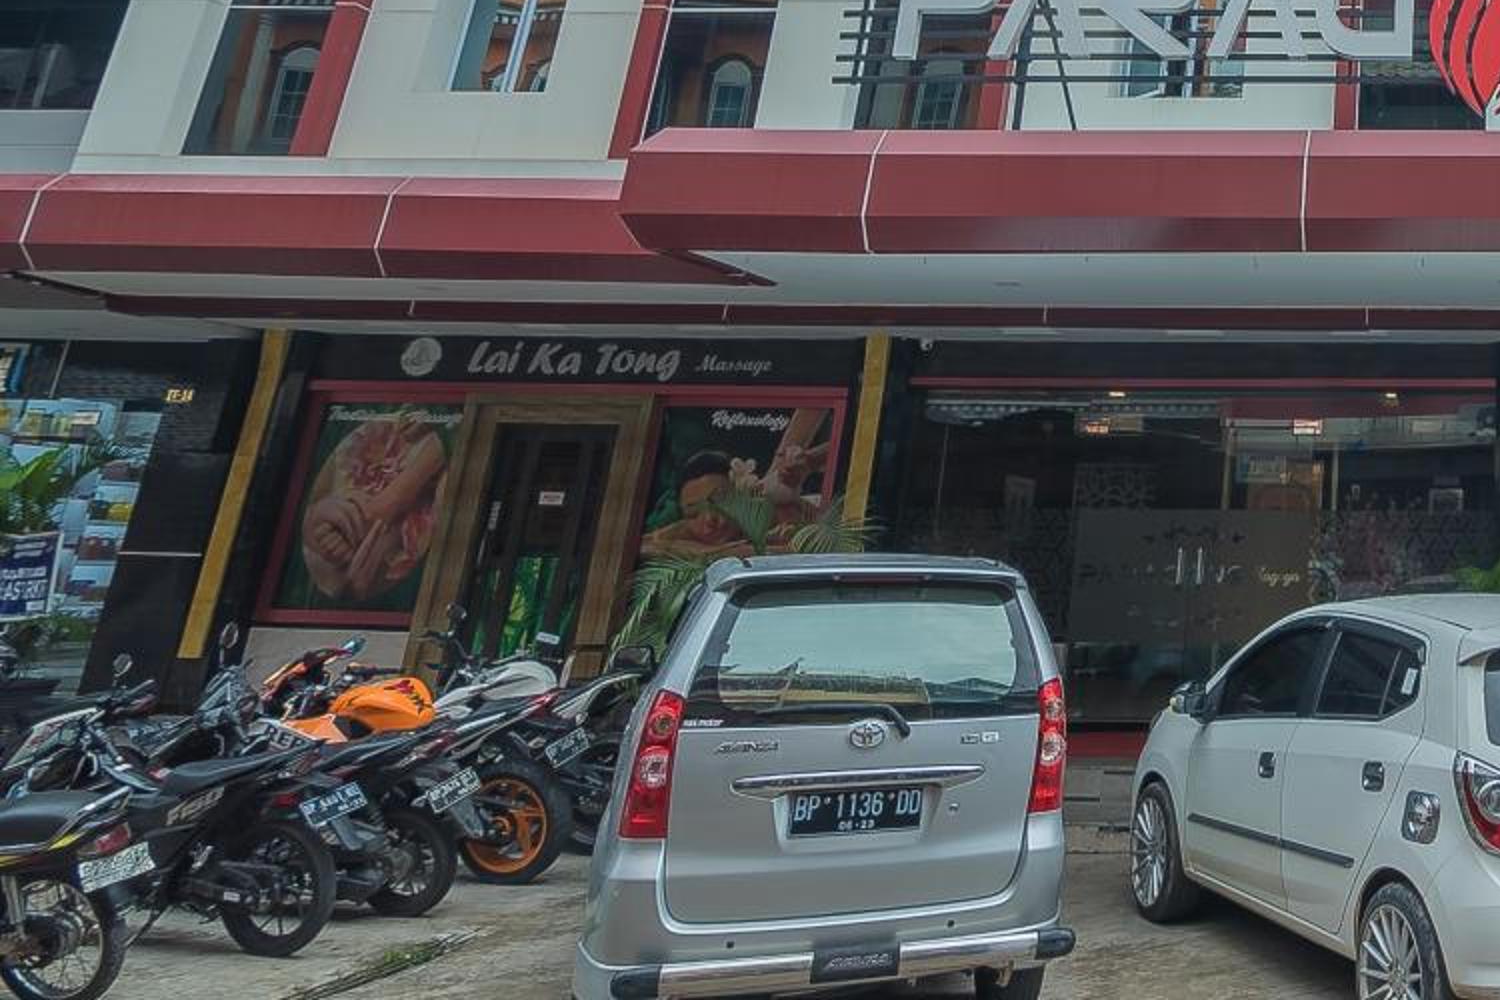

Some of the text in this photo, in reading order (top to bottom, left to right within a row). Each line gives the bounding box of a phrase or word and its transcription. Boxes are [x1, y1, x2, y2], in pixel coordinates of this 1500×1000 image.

[467, 341, 773, 381] Lai Ka Tong Massage
[794, 789, 921, 821] BP 1136 DD
